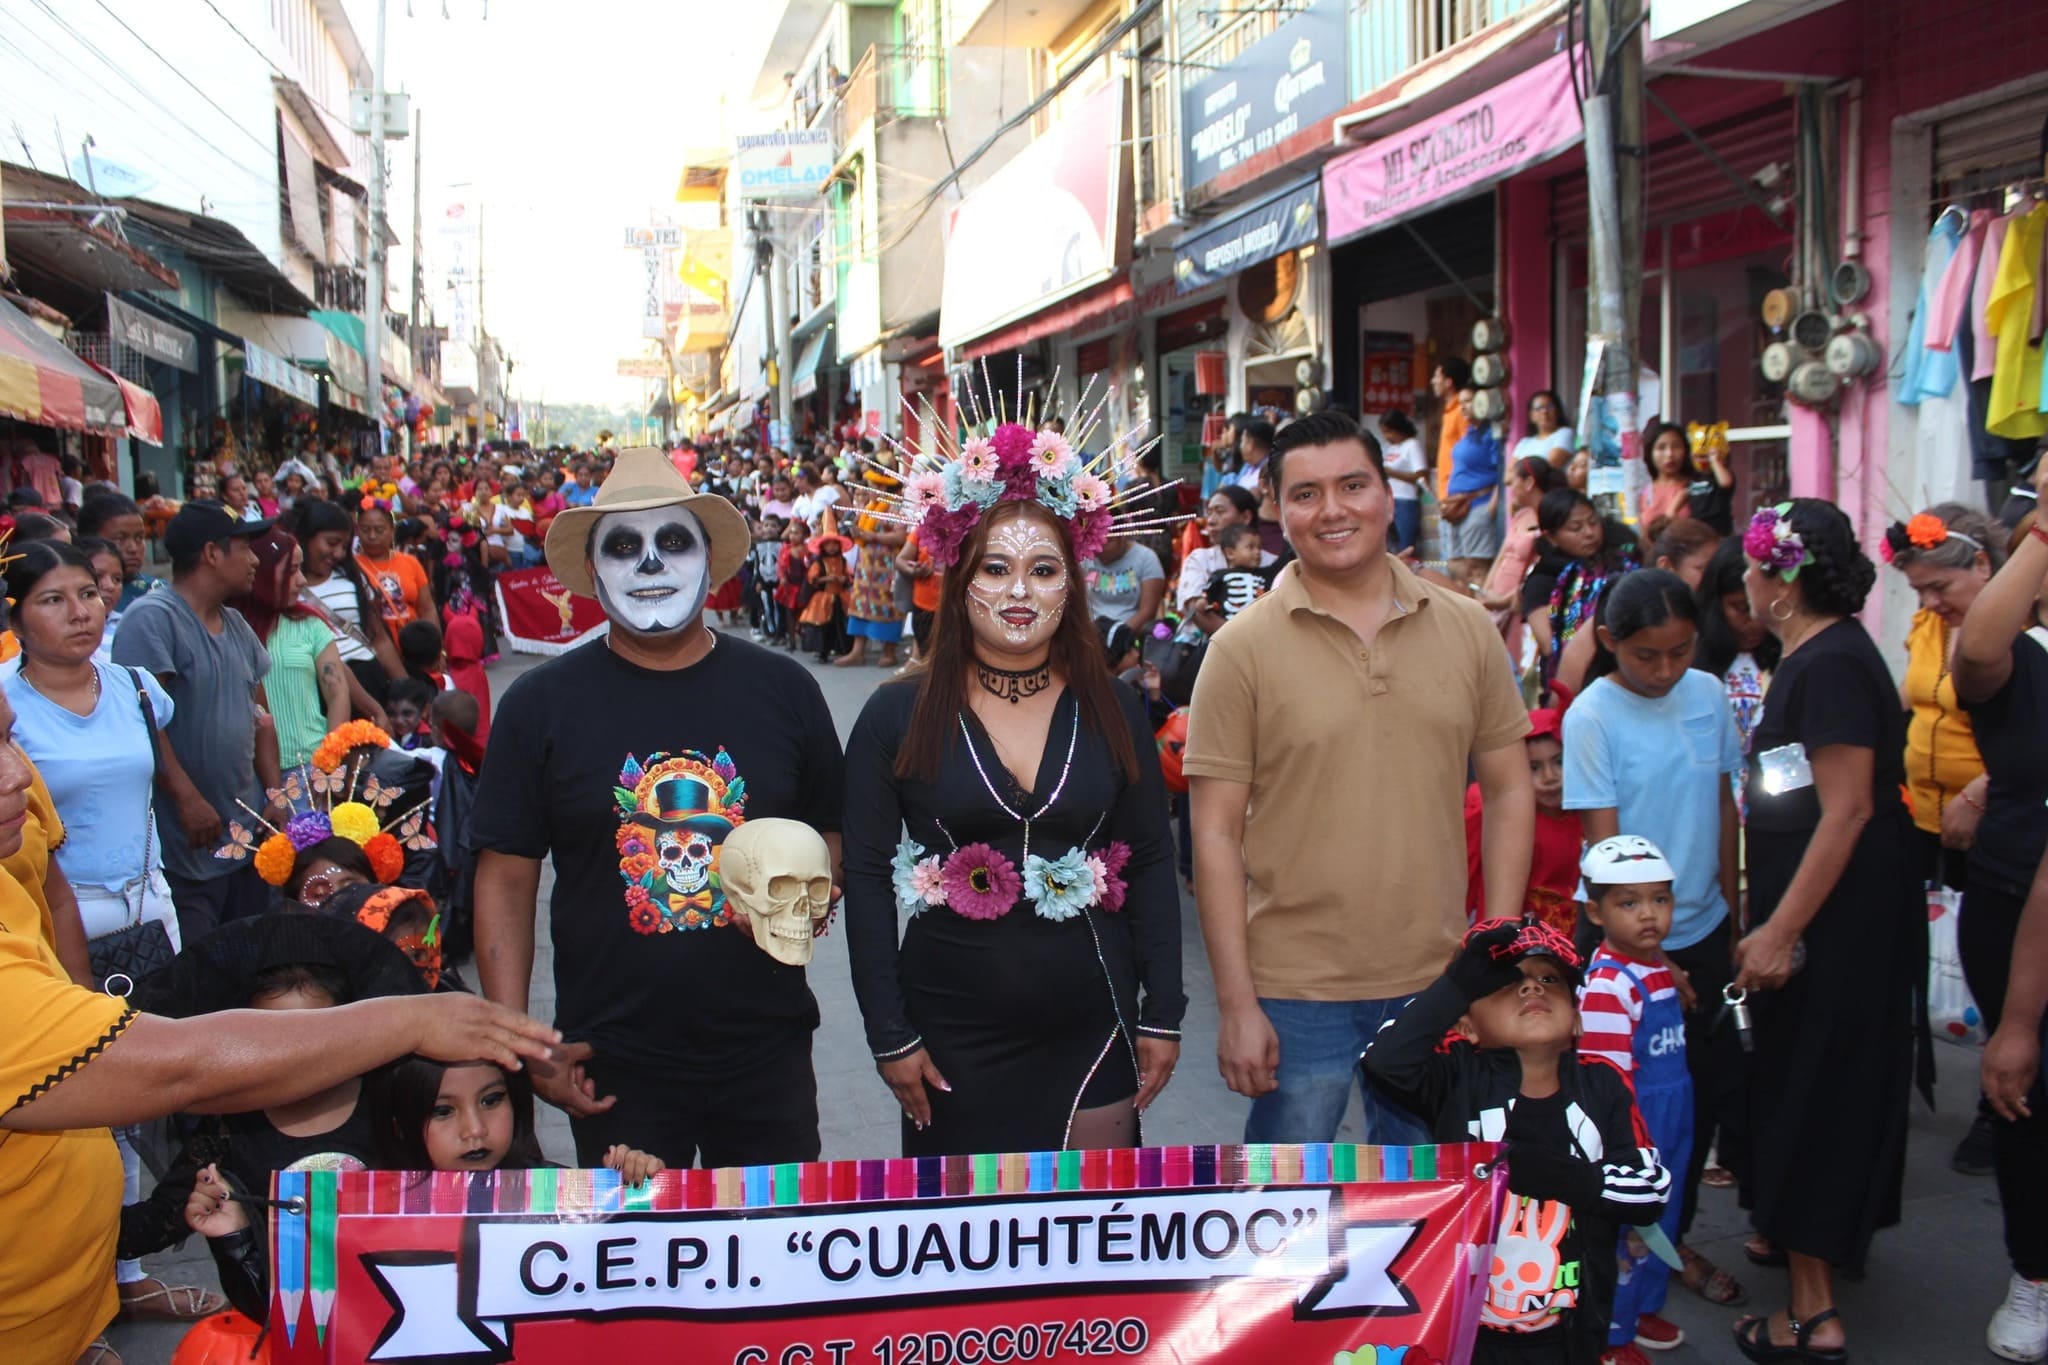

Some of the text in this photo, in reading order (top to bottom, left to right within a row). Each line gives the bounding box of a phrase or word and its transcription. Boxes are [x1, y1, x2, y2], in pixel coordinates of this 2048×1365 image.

[1382, 103, 1495, 189] MI SECRETO
[1433, 136, 1527, 190] Accesorios
[519, 1202, 1317, 1296] C.E.P.I. “CUAUHTÉMOC”
